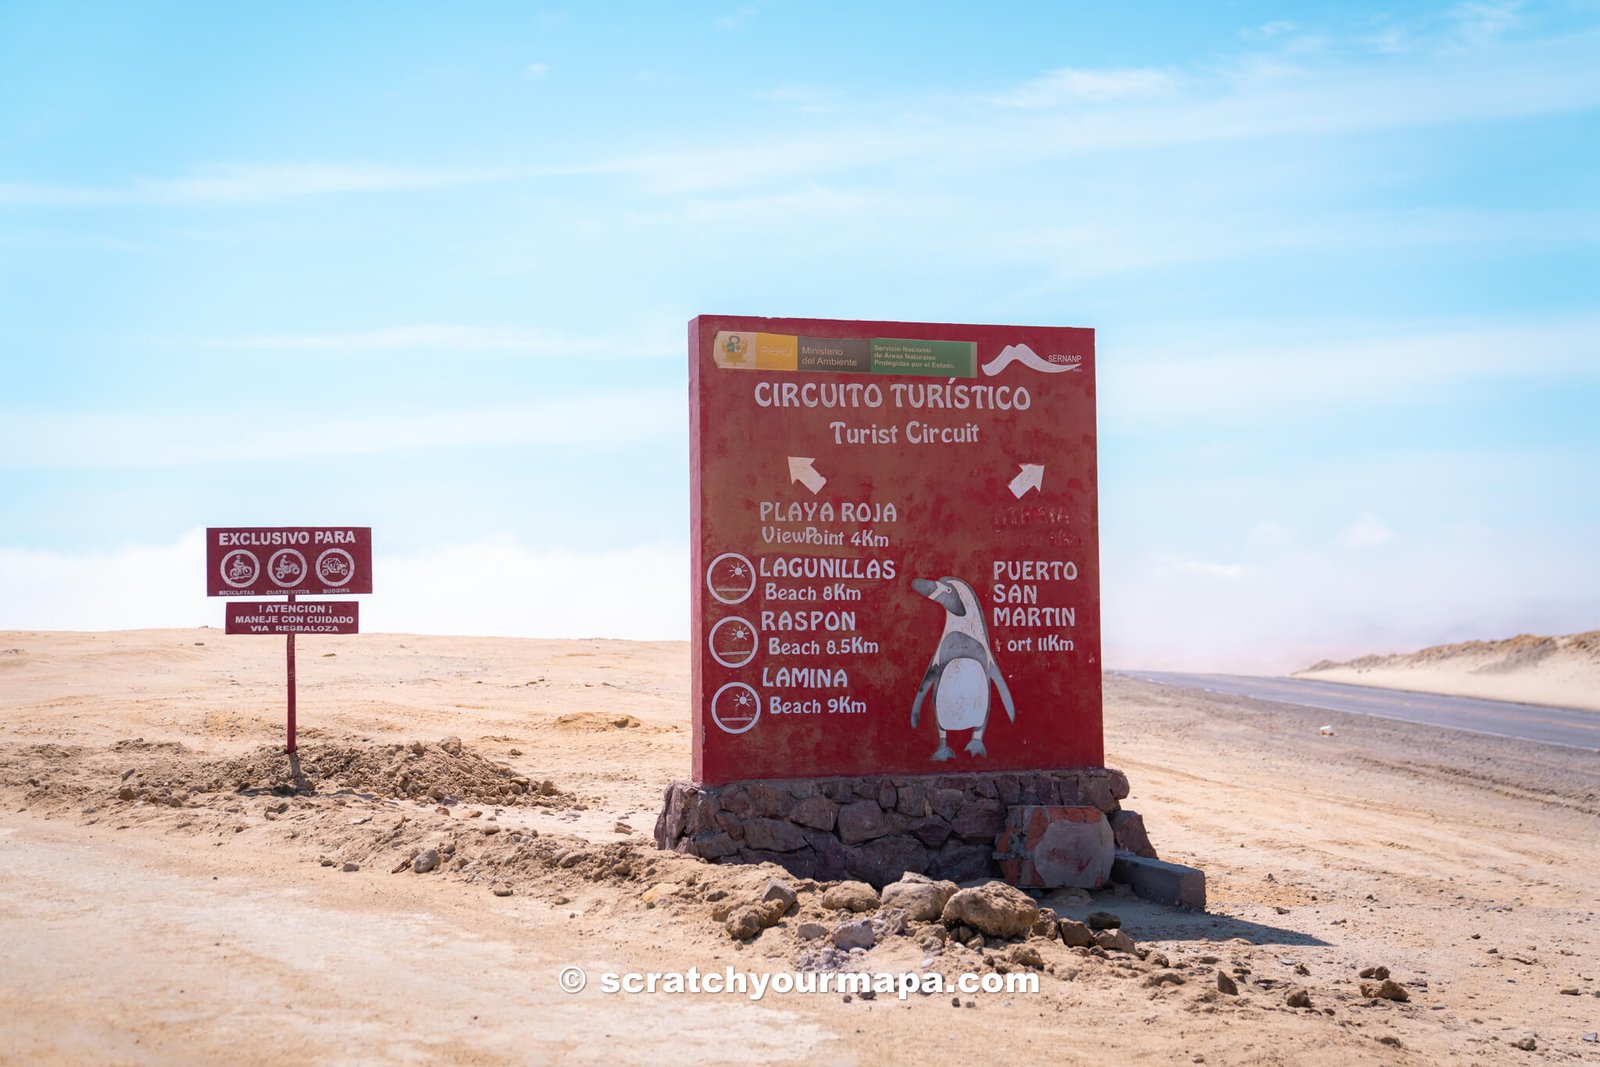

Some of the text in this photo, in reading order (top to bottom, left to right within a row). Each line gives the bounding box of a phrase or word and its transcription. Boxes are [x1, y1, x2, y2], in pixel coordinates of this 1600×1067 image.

[801, 346, 844, 356] Ministerio
[874, 344, 902, 352] Servicio
[817, 358, 857, 367] Ambiente
[874, 360, 910, 368] Protegidas
[1048, 354, 1082, 364] SERNANP
[754, 378, 1031, 410] CIRCUITO TURÍSTICO
[830, 420, 980, 444] Turist Circuit
[759, 501, 897, 523] PLAYA ROJA
[219, 531, 356, 546] EXCLUSIVO PARA
[761, 526, 889, 547] ViewPoint 4Km
[759, 557, 896, 580] LAGUNILLAS
[993, 561, 1078, 580] PUERTO
[765, 582, 861, 601] Beach 8Km
[993, 584, 1037, 604] SAN
[265, 604, 325, 614] ATENCION
[993, 607, 1076, 627] MARTIN
[235, 615, 354, 624] MANEJE CON CUIDADO
[761, 611, 856, 631] RASPON
[768, 636, 879, 655] Beach 8.5Km
[995, 638, 1032, 652] ort
[762, 667, 849, 688] LAMINA
[769, 696, 867, 714] Beach 9Km
